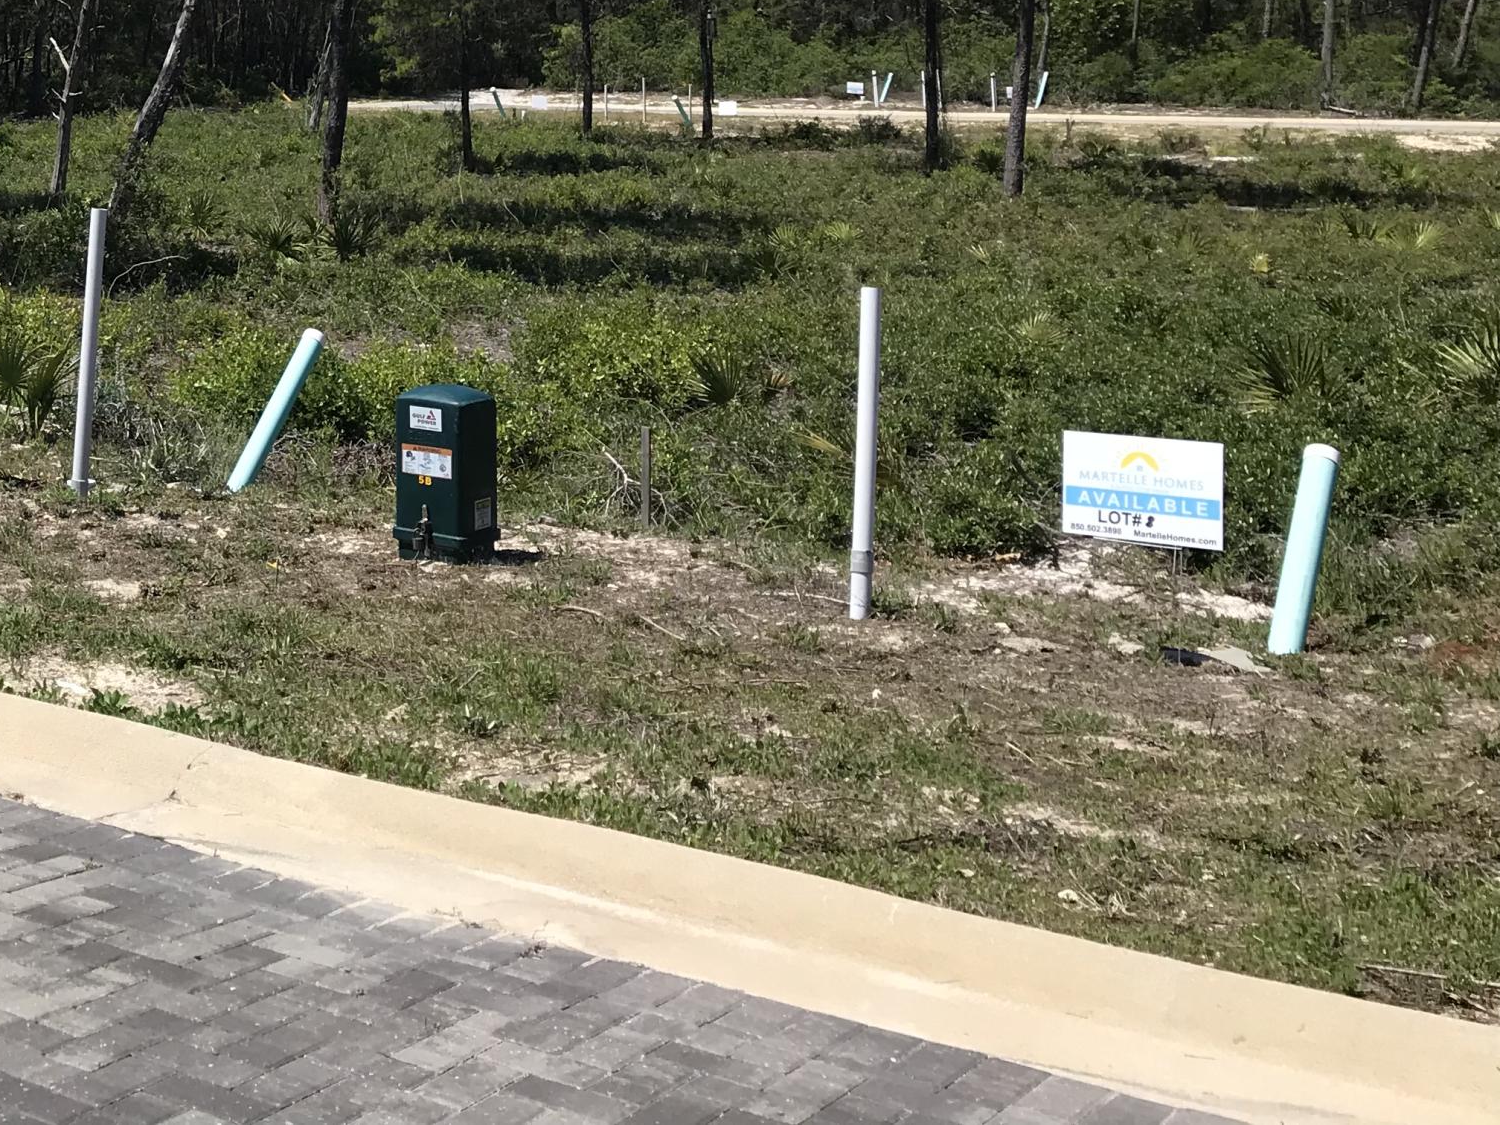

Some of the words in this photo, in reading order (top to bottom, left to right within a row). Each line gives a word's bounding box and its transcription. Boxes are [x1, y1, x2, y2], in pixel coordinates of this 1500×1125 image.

[1079, 470, 1147, 485] MARTELLE
[1153, 477, 1204, 491] HOMES
[1078, 490, 1209, 517] AVAILABLE
[1098, 509, 1142, 527] LOT#
[1133, 529, 1217, 546] MartelleHomes.com
